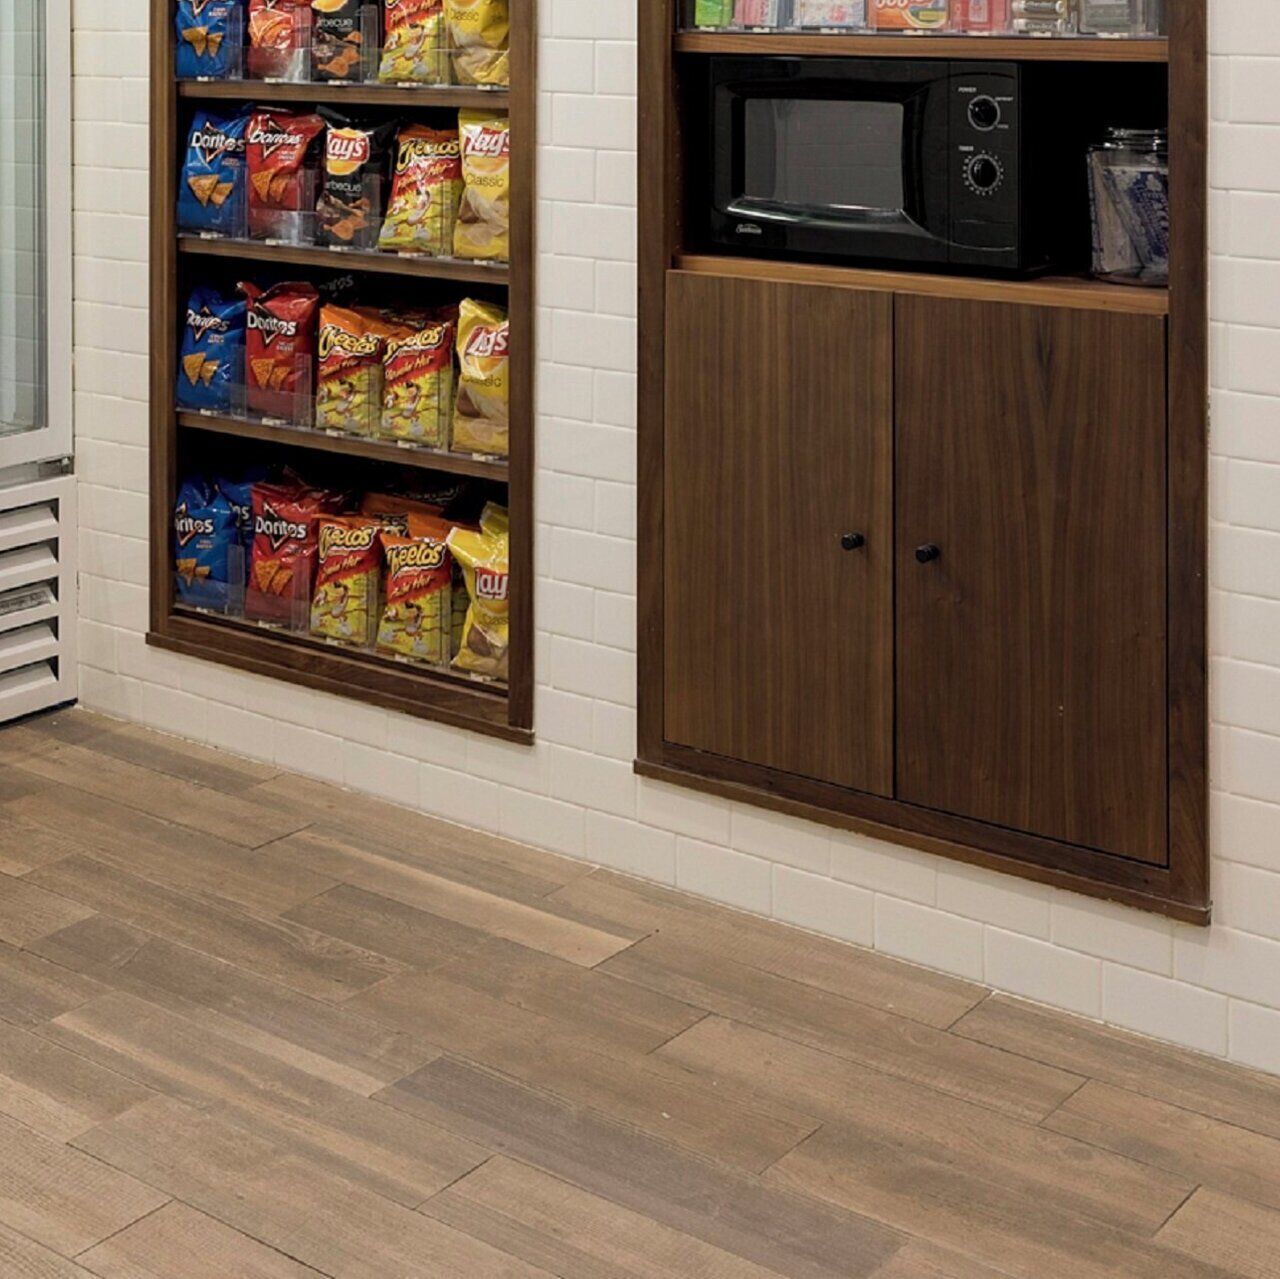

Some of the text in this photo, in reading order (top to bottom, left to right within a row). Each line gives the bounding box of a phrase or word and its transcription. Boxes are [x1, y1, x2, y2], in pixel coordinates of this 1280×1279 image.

[191, 131, 245, 153] Doritos
[466, 173, 504, 189] Classic
[247, 311, 296, 336] Doritos
[255, 516, 307, 539] Doritos
